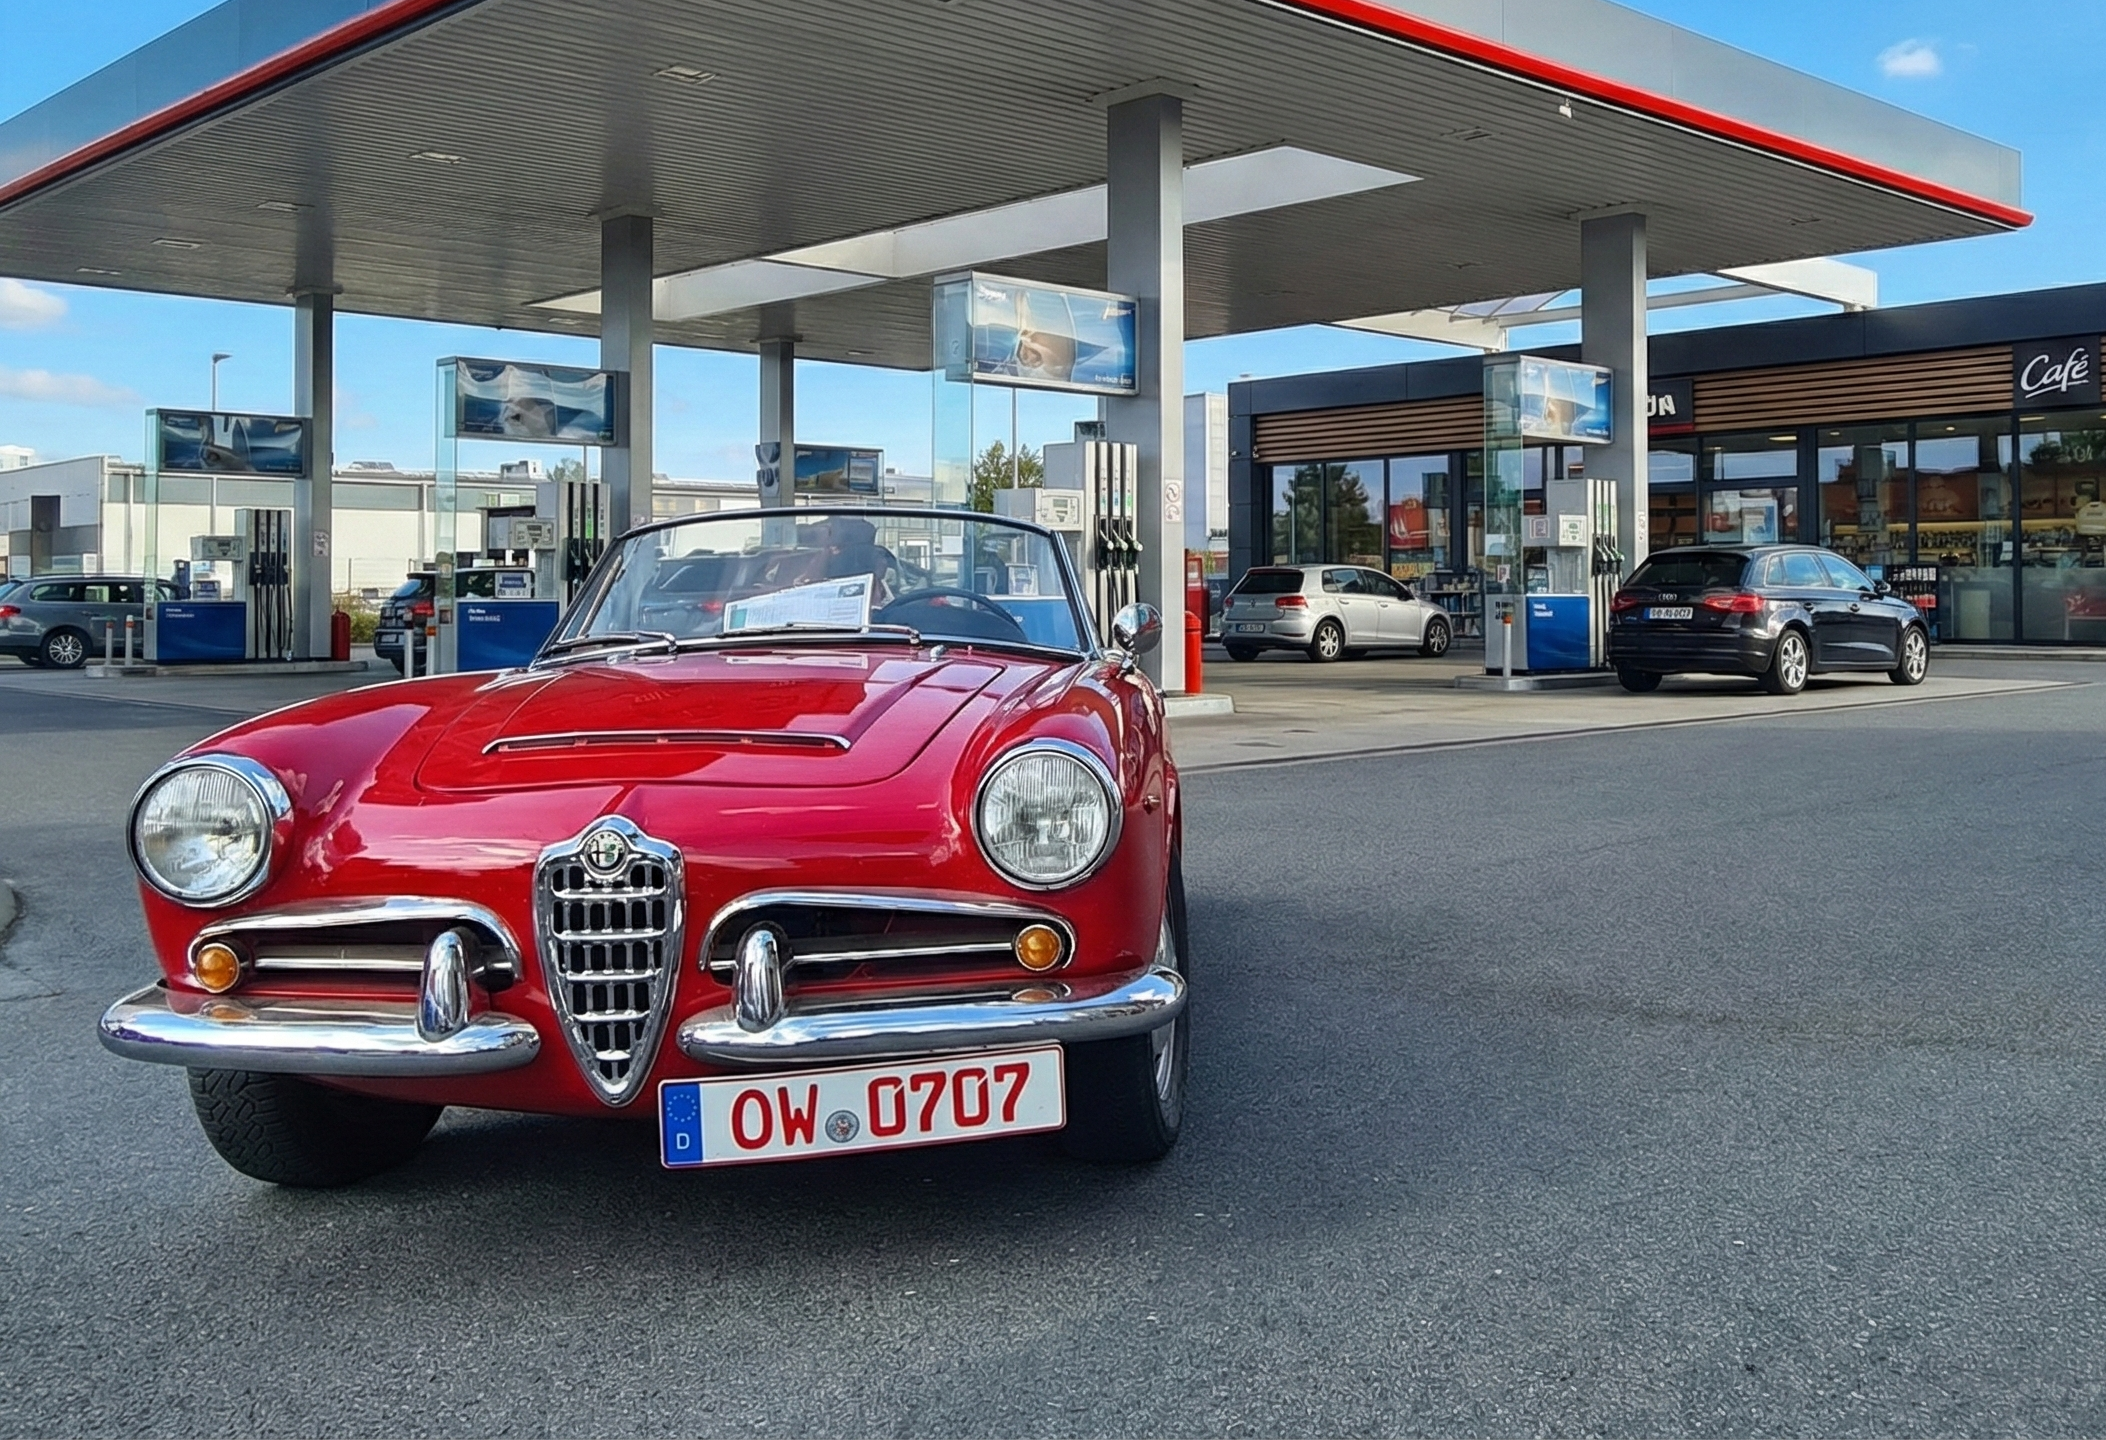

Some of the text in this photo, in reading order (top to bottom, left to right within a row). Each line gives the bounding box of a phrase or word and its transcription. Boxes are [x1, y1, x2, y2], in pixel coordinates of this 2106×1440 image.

[2020, 347, 2090, 393] Café
[731, 1061, 1030, 1150] OW 0707
[676, 1133, 690, 1150] D
